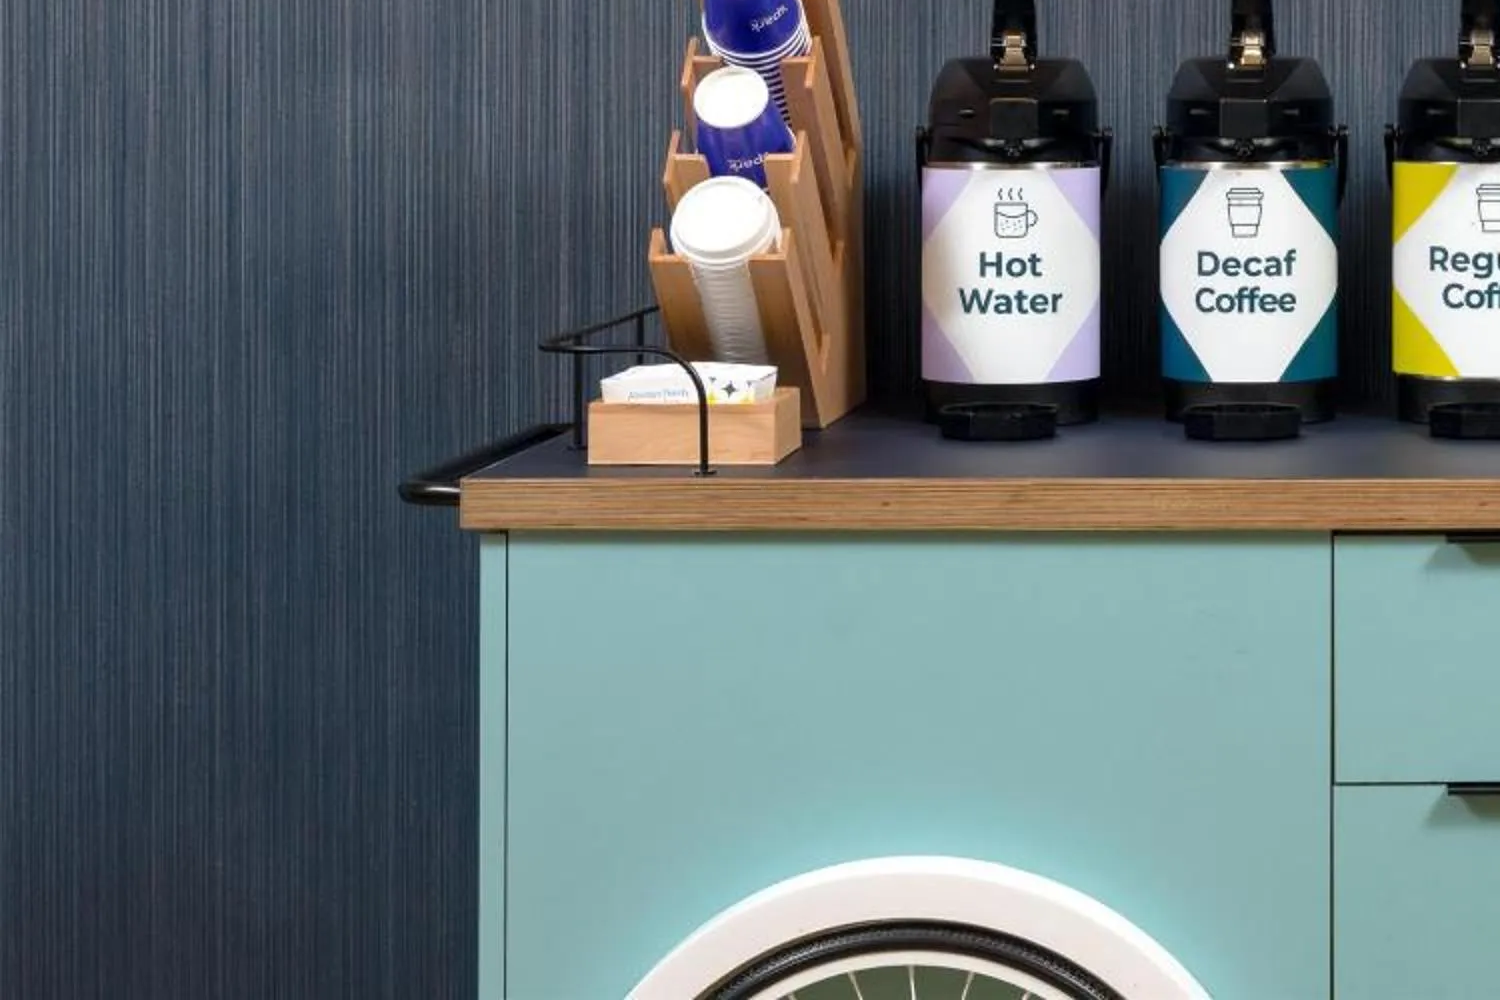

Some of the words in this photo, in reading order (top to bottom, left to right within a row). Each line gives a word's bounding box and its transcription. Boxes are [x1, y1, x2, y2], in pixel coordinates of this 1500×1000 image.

[726, 152, 765, 173] park
[979, 251, 1043, 278] Hot
[1197, 249, 1297, 277] Decaf
[958, 287, 1063, 315] Water
[1195, 286, 1297, 313] Coffee
